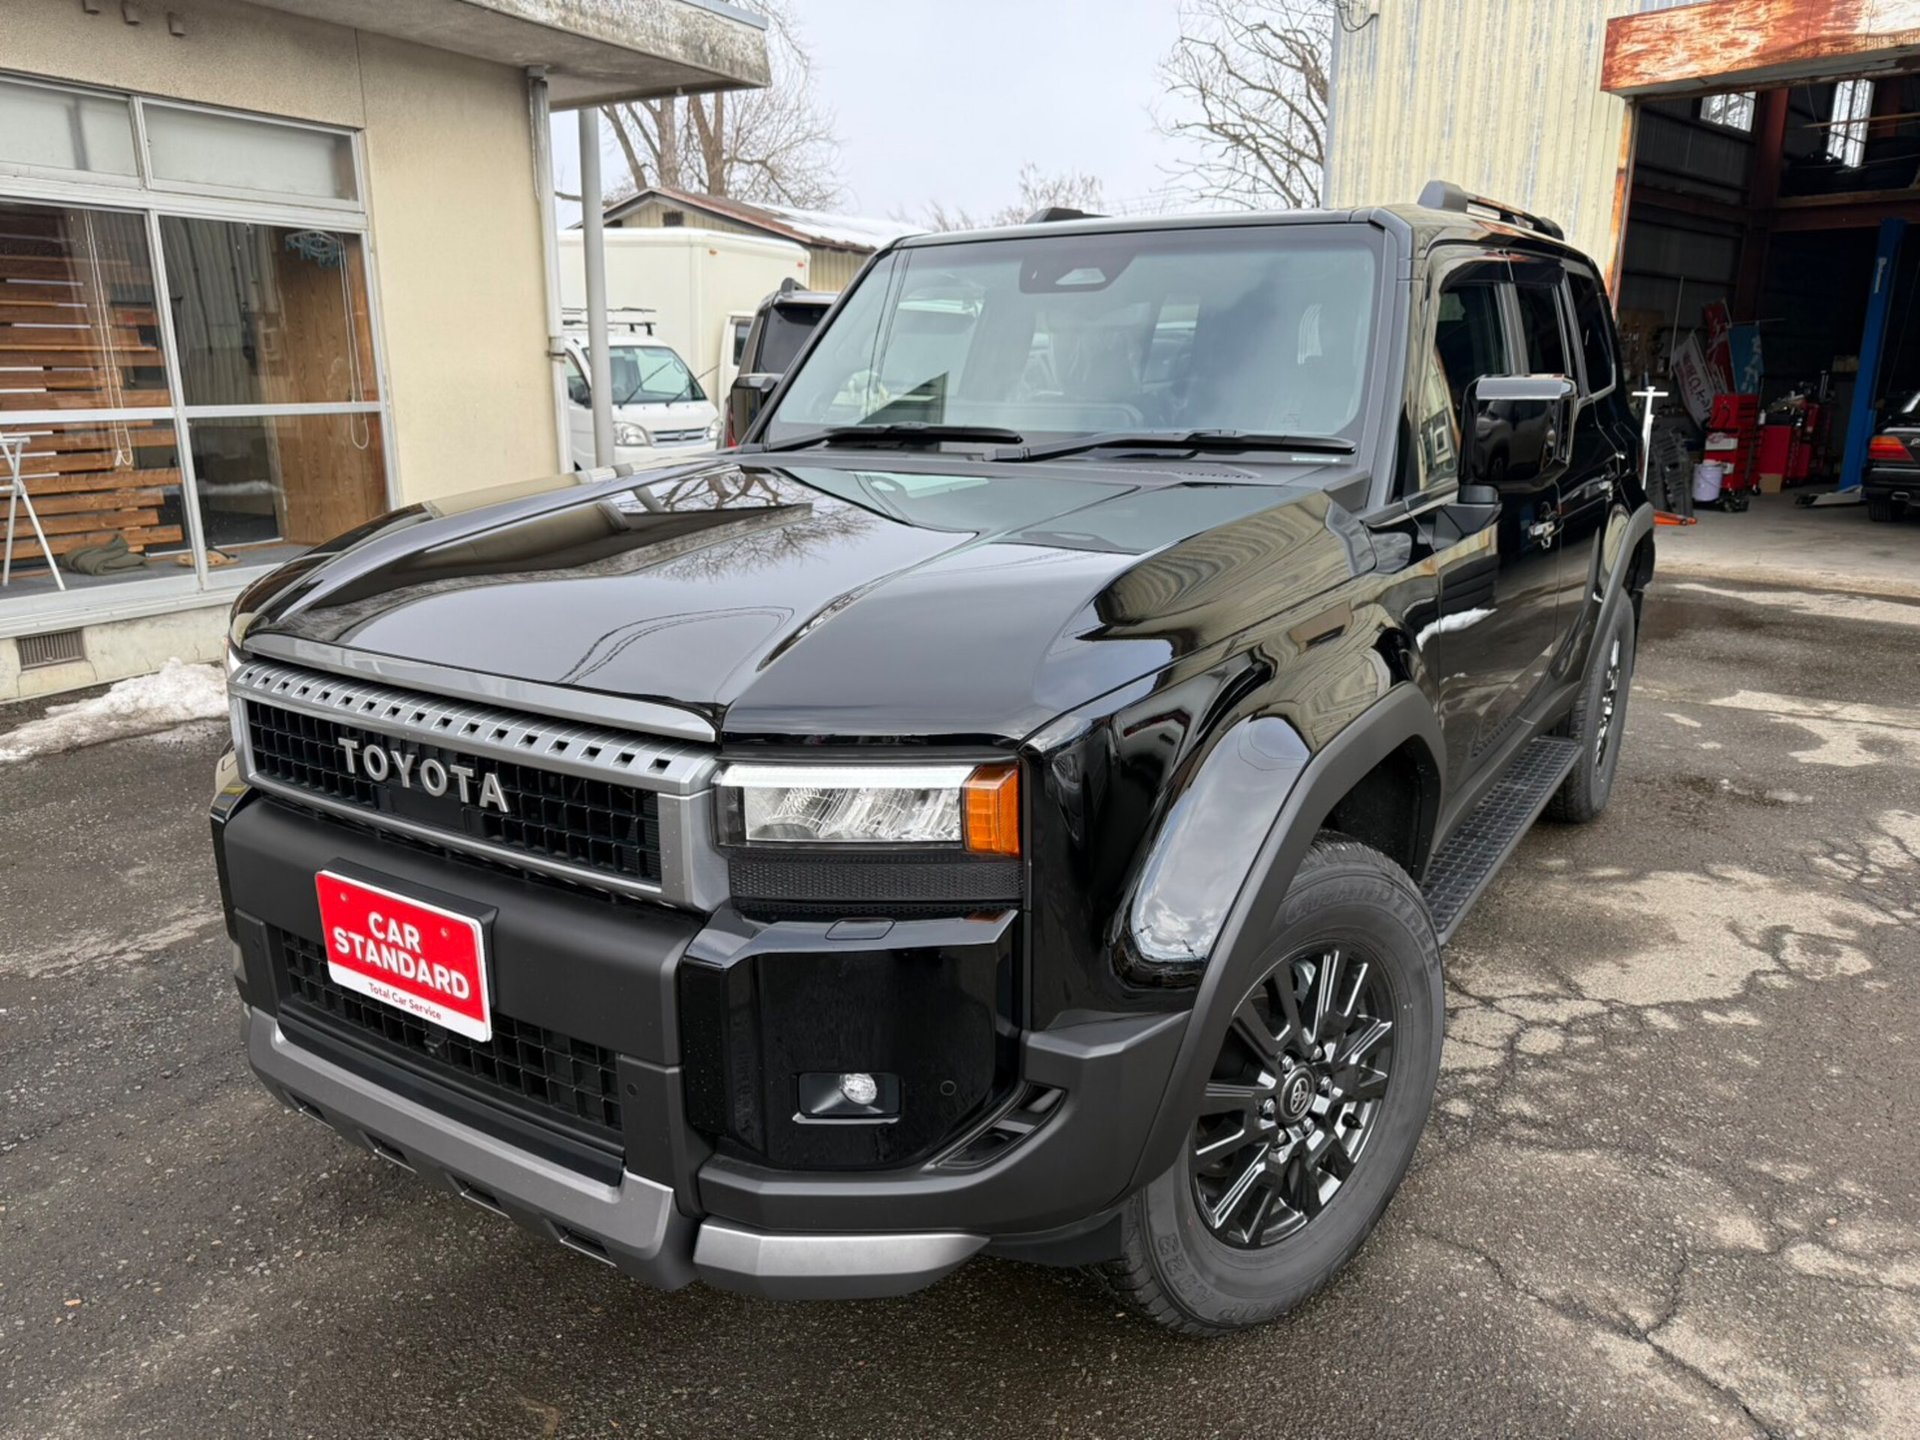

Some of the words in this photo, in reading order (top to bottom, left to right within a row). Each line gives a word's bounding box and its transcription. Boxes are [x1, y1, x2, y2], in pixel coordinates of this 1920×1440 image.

[337, 737, 509, 813] TOYOTA
[368, 911, 422, 953] CAR
[333, 926, 471, 1000] STANDARD
[368, 982, 391, 998] Total
[392, 992, 407, 1006] Car
[409, 999, 442, 1020] Service
